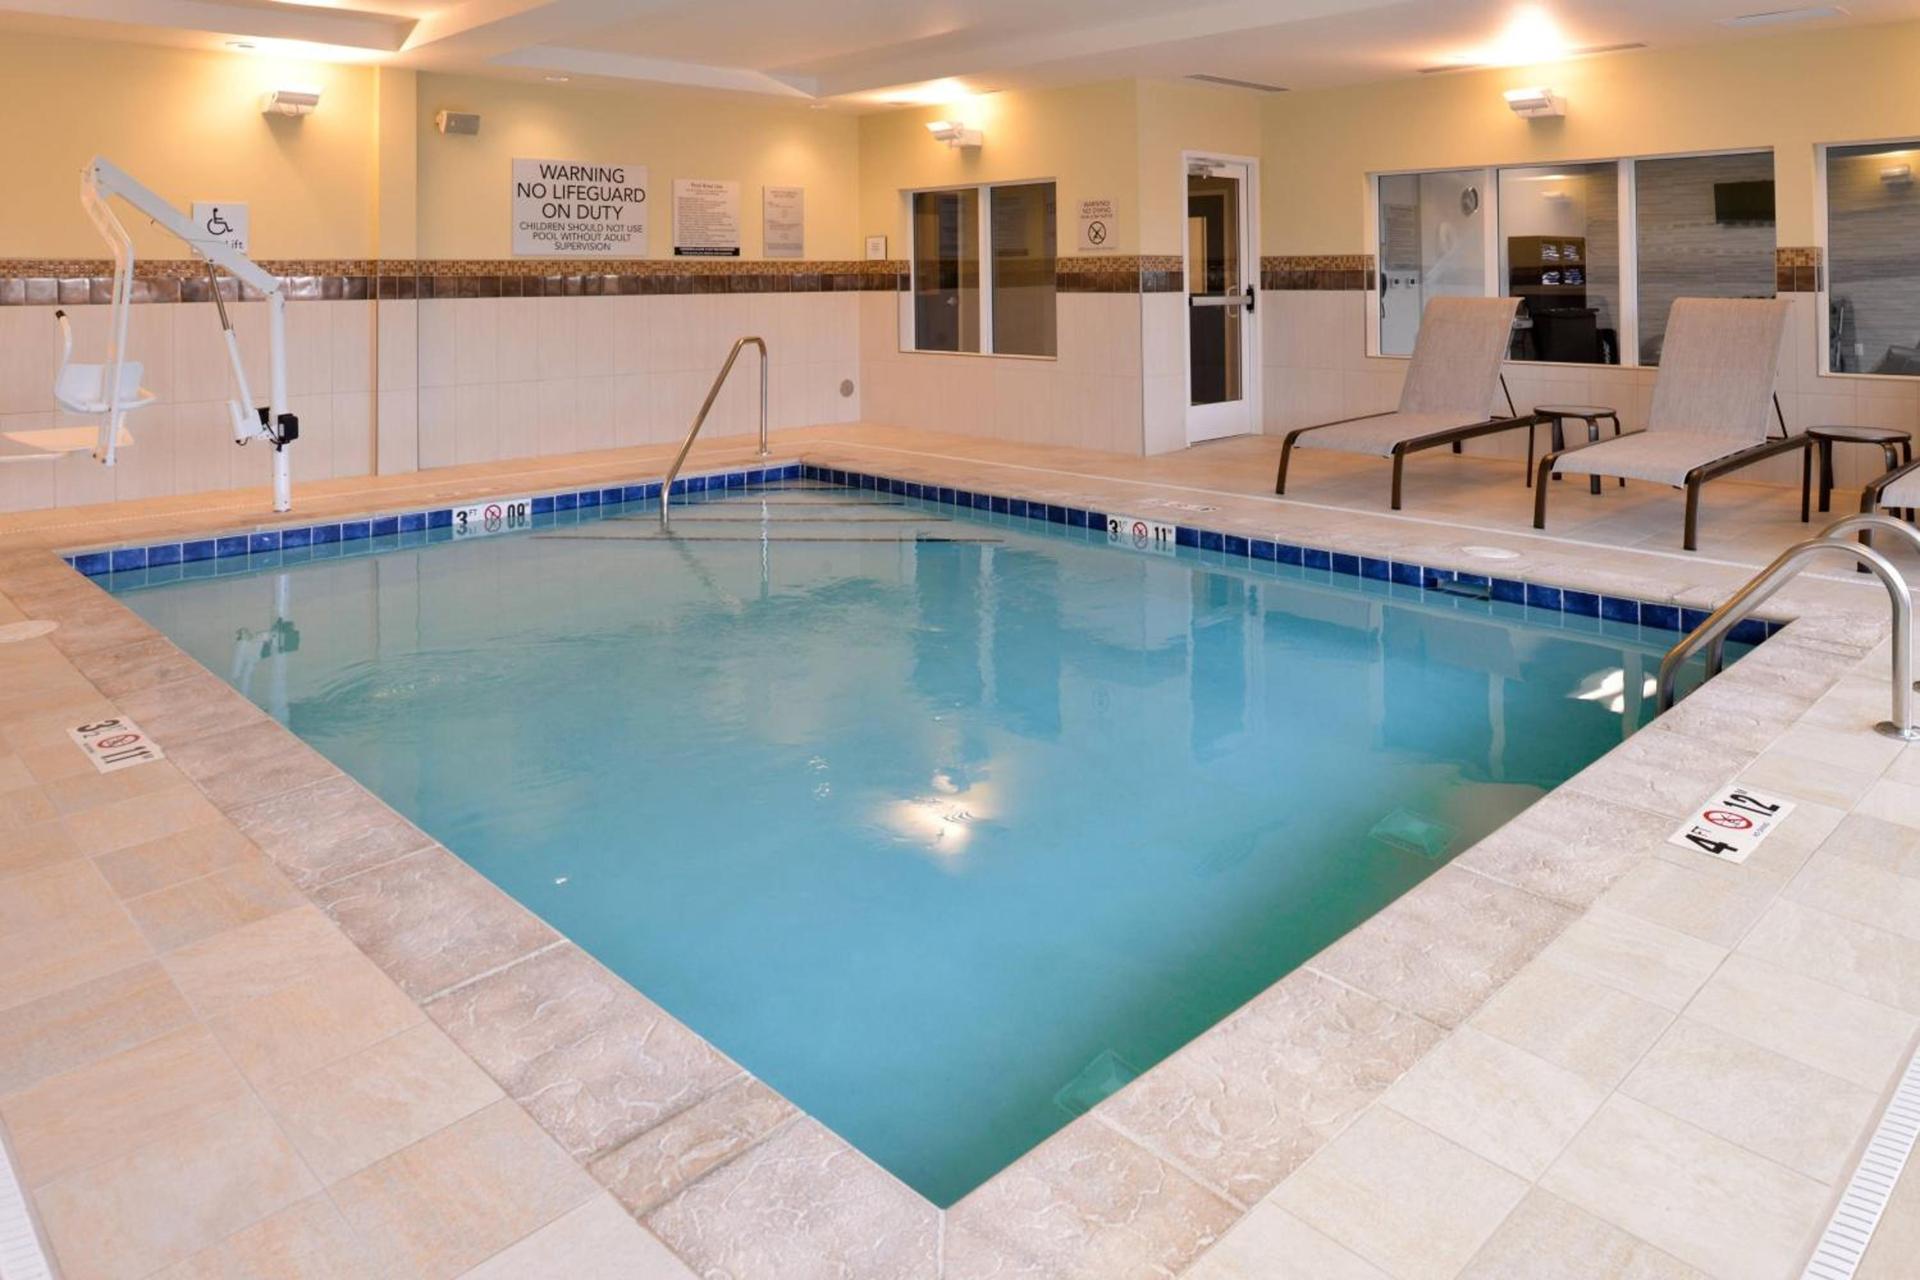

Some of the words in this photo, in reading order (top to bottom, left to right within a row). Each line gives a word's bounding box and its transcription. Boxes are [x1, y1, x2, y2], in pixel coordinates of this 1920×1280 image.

[540, 164, 625, 184] WARNING
[517, 182, 547, 199] NO
[553, 184, 646, 203] LIFEGUARD
[542, 202, 571, 219] ON
[577, 204, 623, 220] DUTY
[519, 221, 565, 231] CHILDREN
[567, 222, 604, 232] SHOULD
[606, 224, 625, 232] NOT
[626, 225, 643, 233] USE
[532, 231, 558, 240] POOL
[560, 232, 602, 241] WITHOUT
[603, 233, 632, 241] ADULT
[554, 242, 612, 251] SUPERVISION
[1685, 833, 1738, 854] 4
